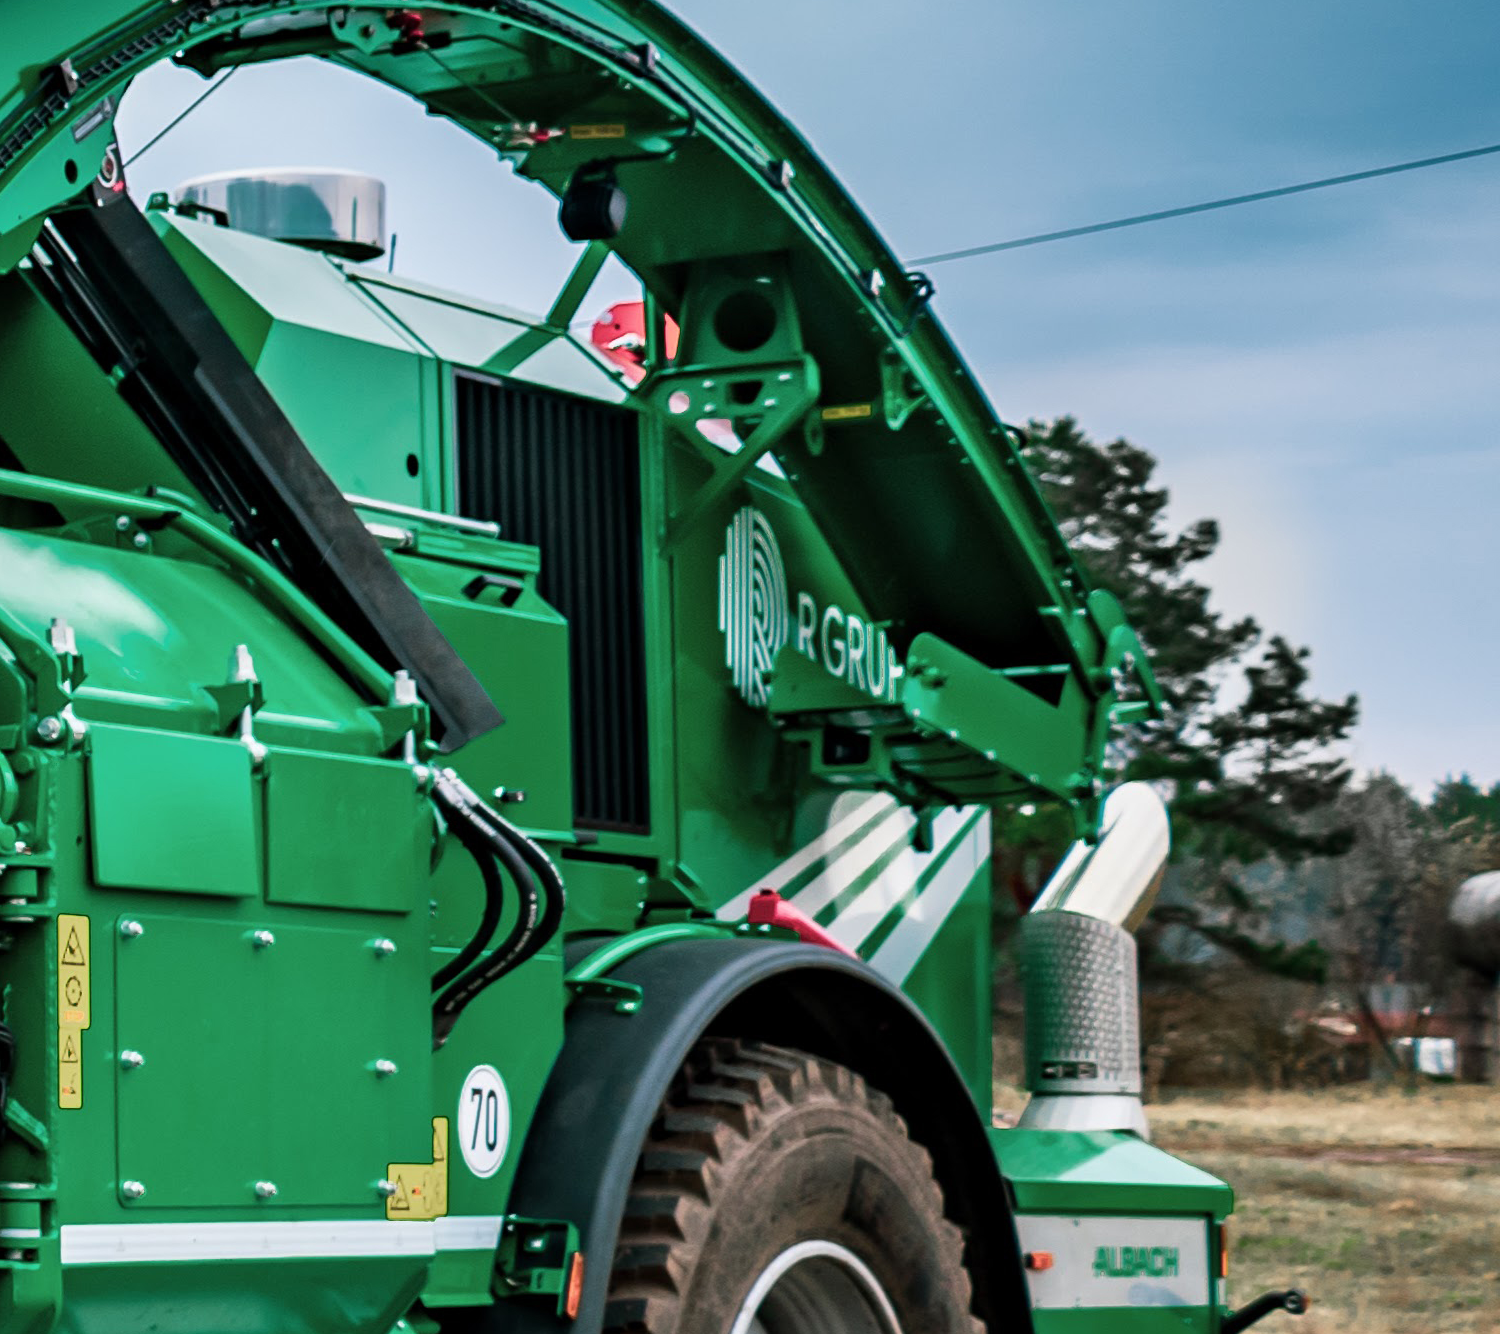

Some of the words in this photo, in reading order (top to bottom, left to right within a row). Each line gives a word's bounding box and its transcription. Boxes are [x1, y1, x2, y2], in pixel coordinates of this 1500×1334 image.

[798, 591, 817, 663] R
[471, 1088, 498, 1152] 70
[1093, 1246, 1179, 1278] ALBACH
